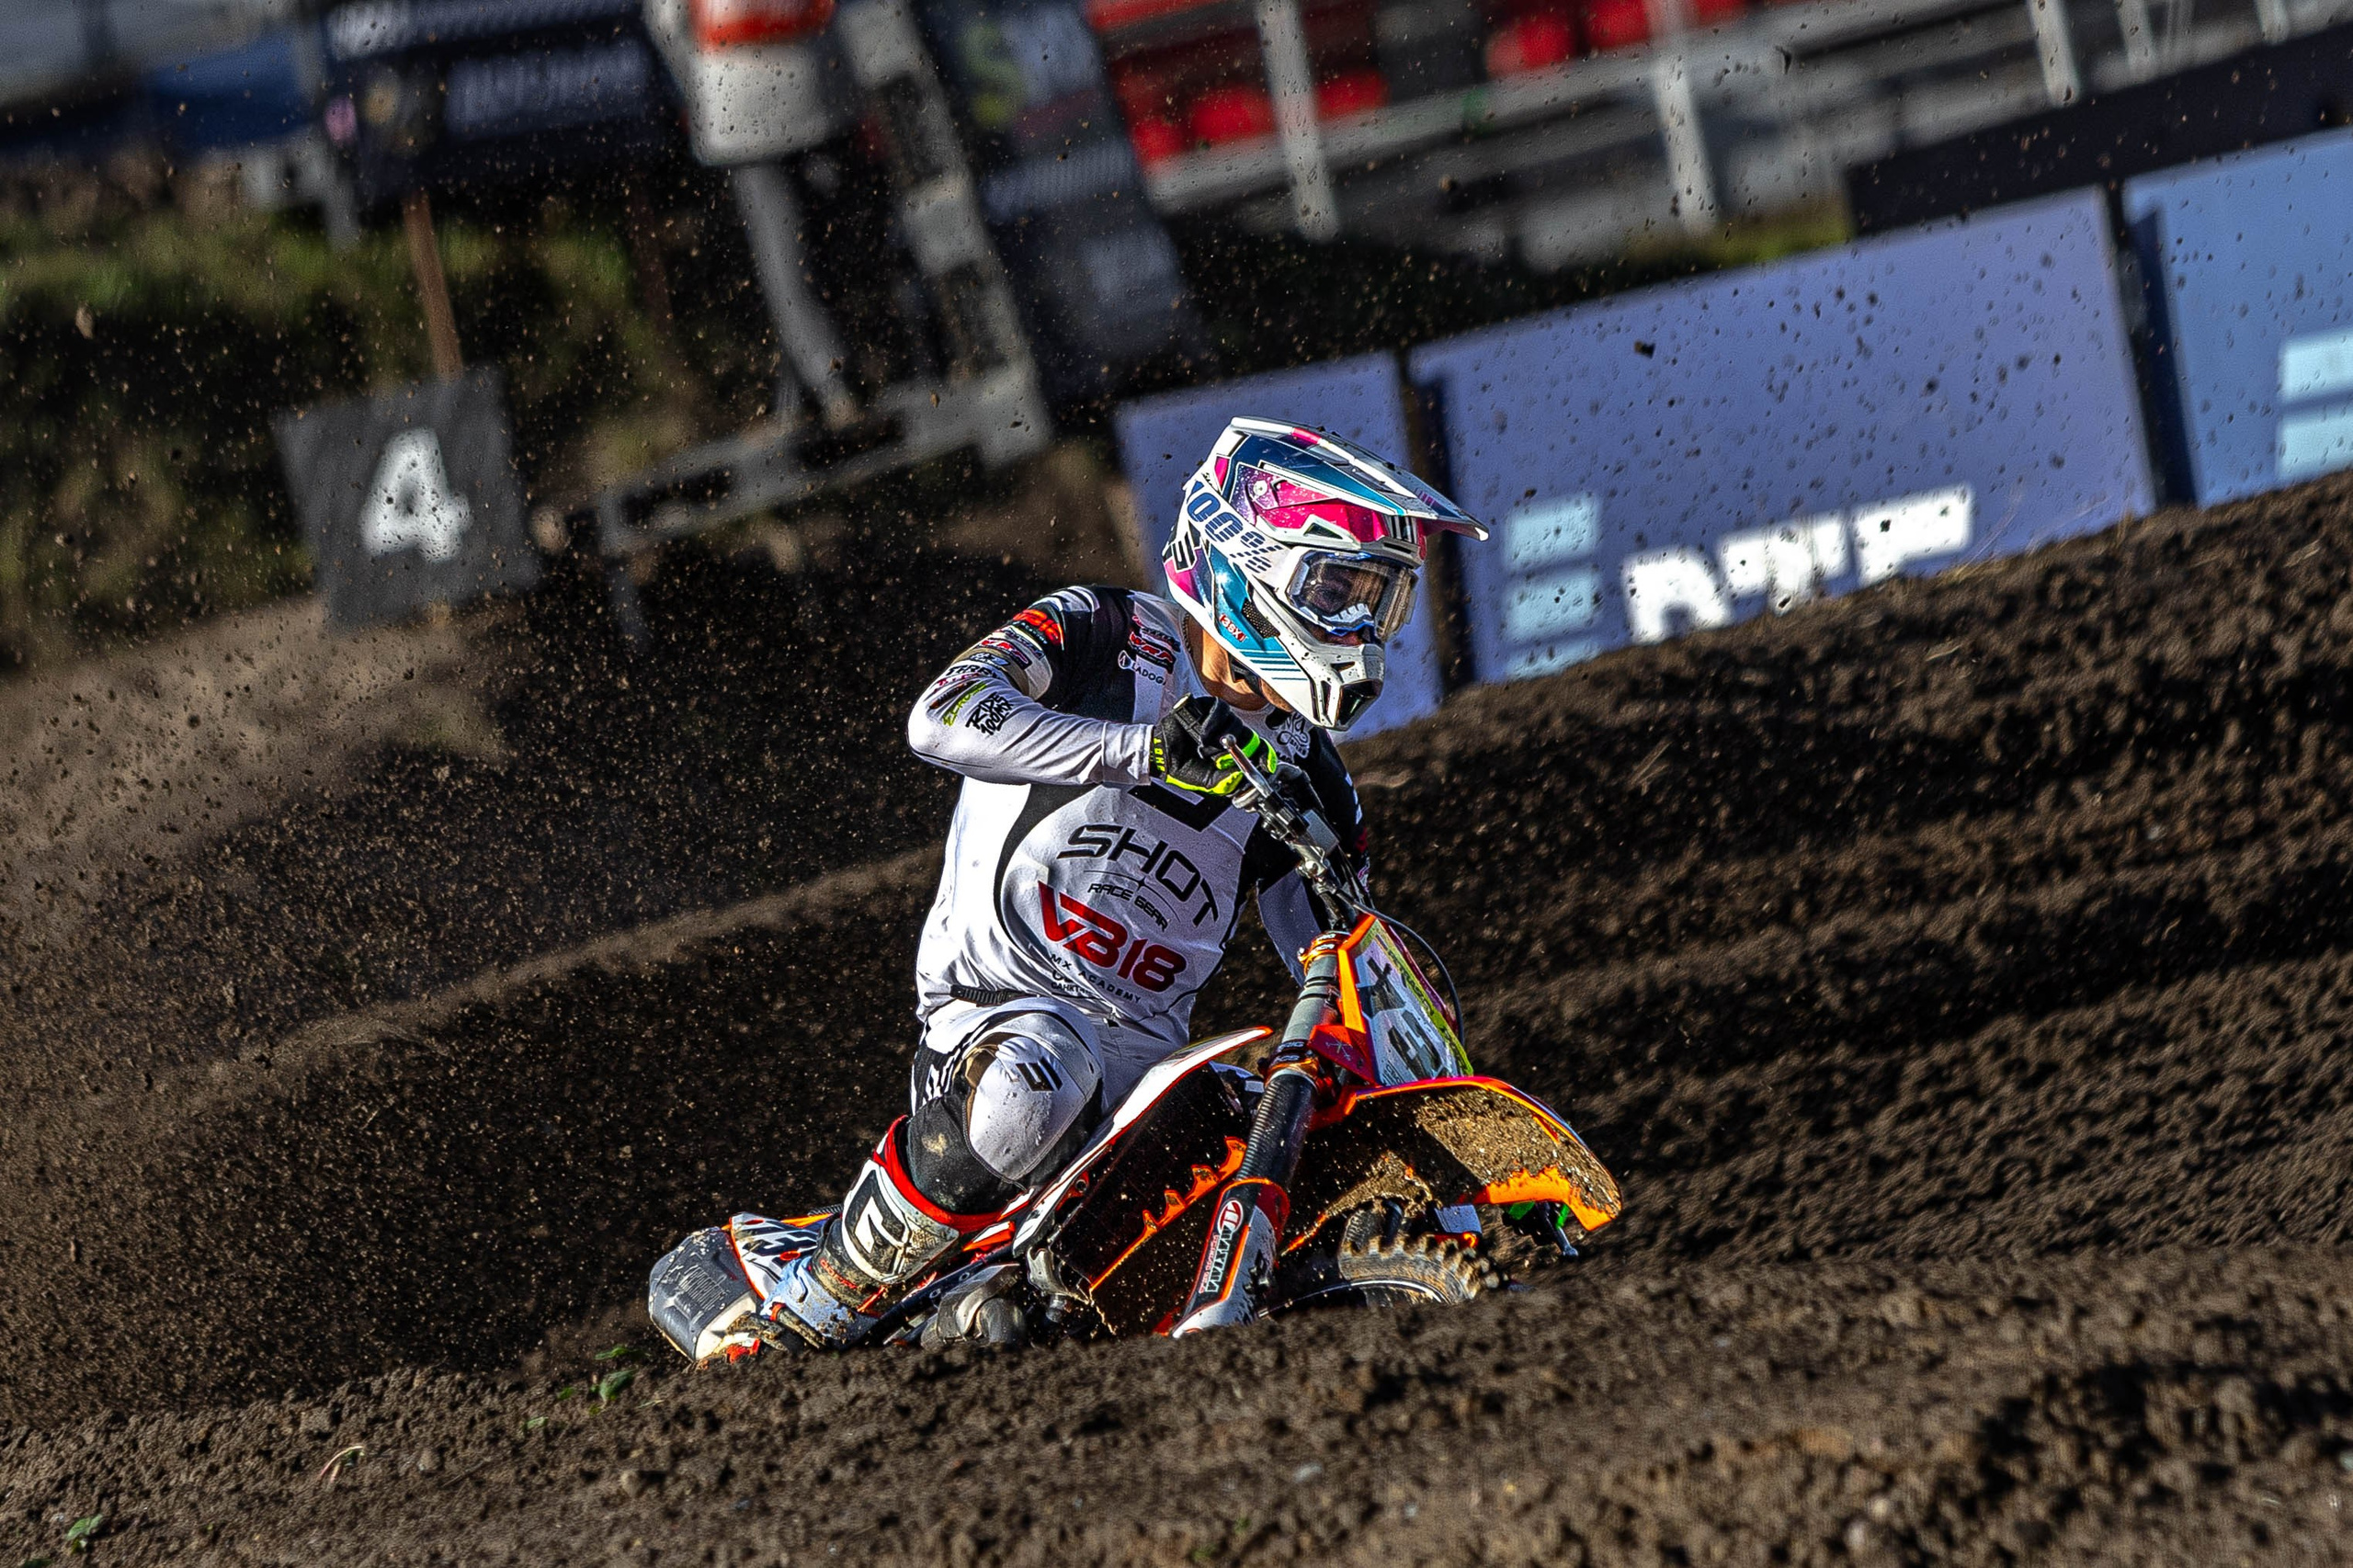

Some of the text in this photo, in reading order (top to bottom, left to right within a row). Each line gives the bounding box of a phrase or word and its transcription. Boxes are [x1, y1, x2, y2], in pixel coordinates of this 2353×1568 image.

[360, 426, 472, 562] 4
[965, 691, 1003, 729] RIDE
[1057, 824, 1219, 927] SHOT
[1087, 883, 1169, 932] RACE GEAR
[1038, 880, 1187, 993] VB18
[1050, 953, 1073, 971] MX
[1078, 970, 1142, 1004] ACADEMY
[1205, 1224, 1233, 1292] MAXIMA
